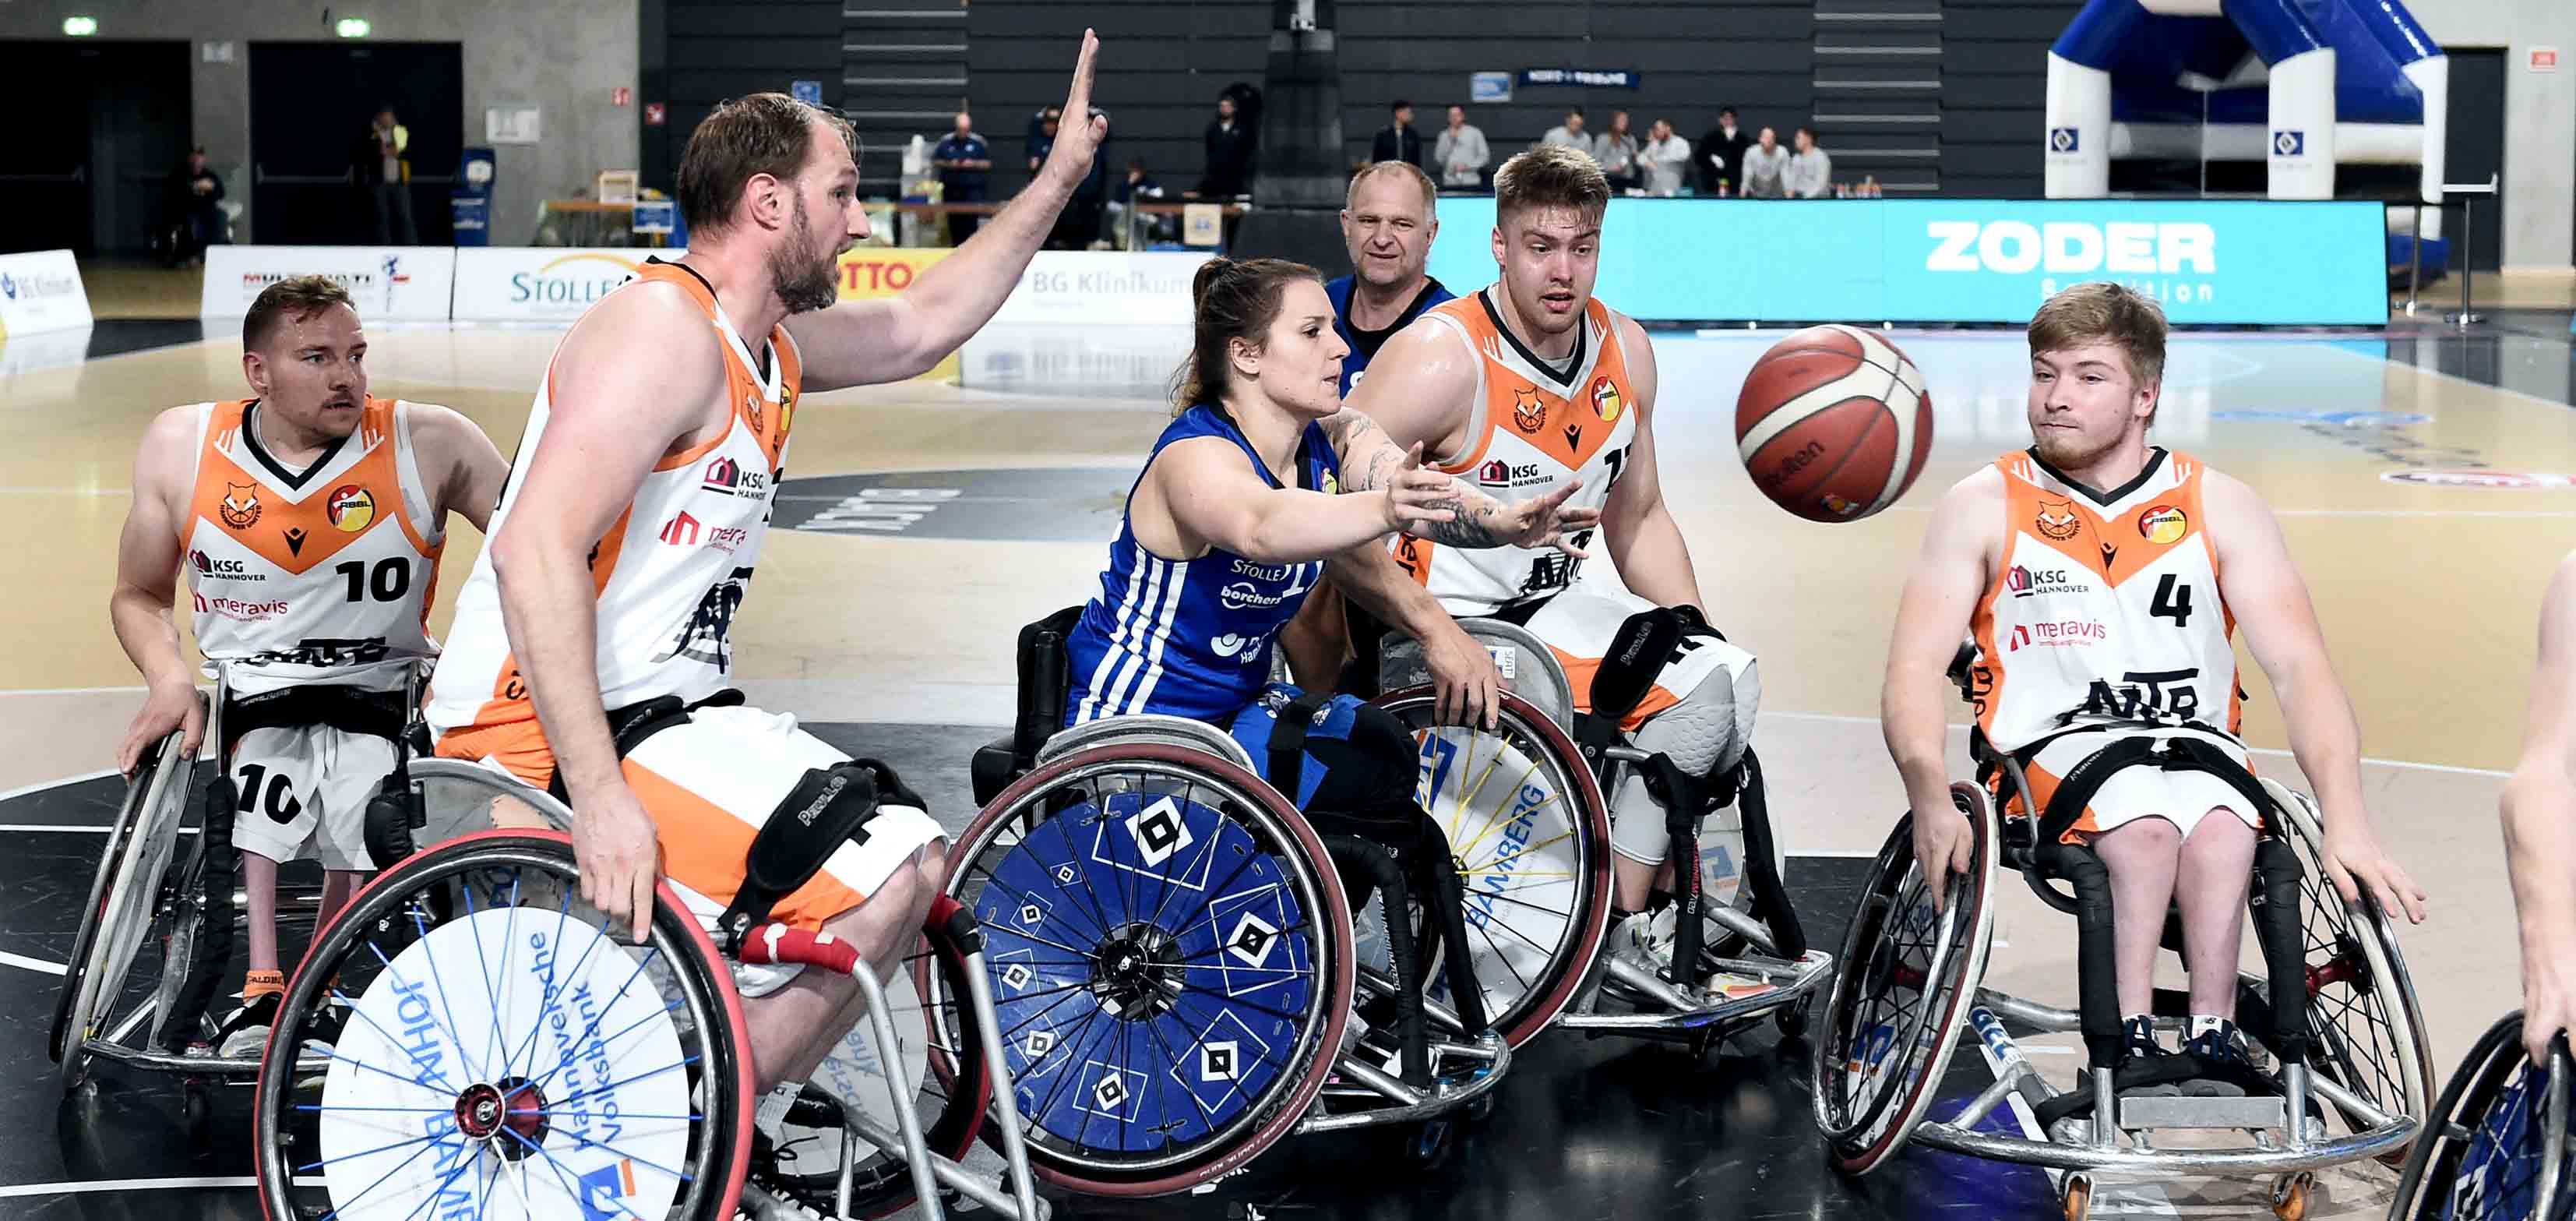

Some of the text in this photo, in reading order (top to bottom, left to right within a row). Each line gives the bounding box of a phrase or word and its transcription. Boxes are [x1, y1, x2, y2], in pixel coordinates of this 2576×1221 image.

[1926, 219, 2216, 273] ZODER
[1034, 267, 1192, 295] BG Klinikum
[1511, 464, 1538, 478] KSG
[1511, 475, 1553, 489] HANNOVER
[340, 500, 371, 509] RBBL
[213, 559, 244, 573] KSG
[1231, 559, 1282, 582] STOLLE
[215, 572, 266, 582] HANNOVER
[335, 556, 411, 603] 10
[2035, 570, 2067, 585] KSG
[1221, 585, 1282, 605] borchers
[2035, 585, 2089, 595] HANNOVER
[2149, 573, 2193, 628] 4
[212, 595, 288, 616] meravis
[2035, 618, 2106, 639] meravis
[1465, 784, 1545, 930] BAMBERG
[391, 979, 446, 1085] JOHN
[530, 930, 595, 1152] Hannoversche
[570, 980, 622, 1145] Volksbank
